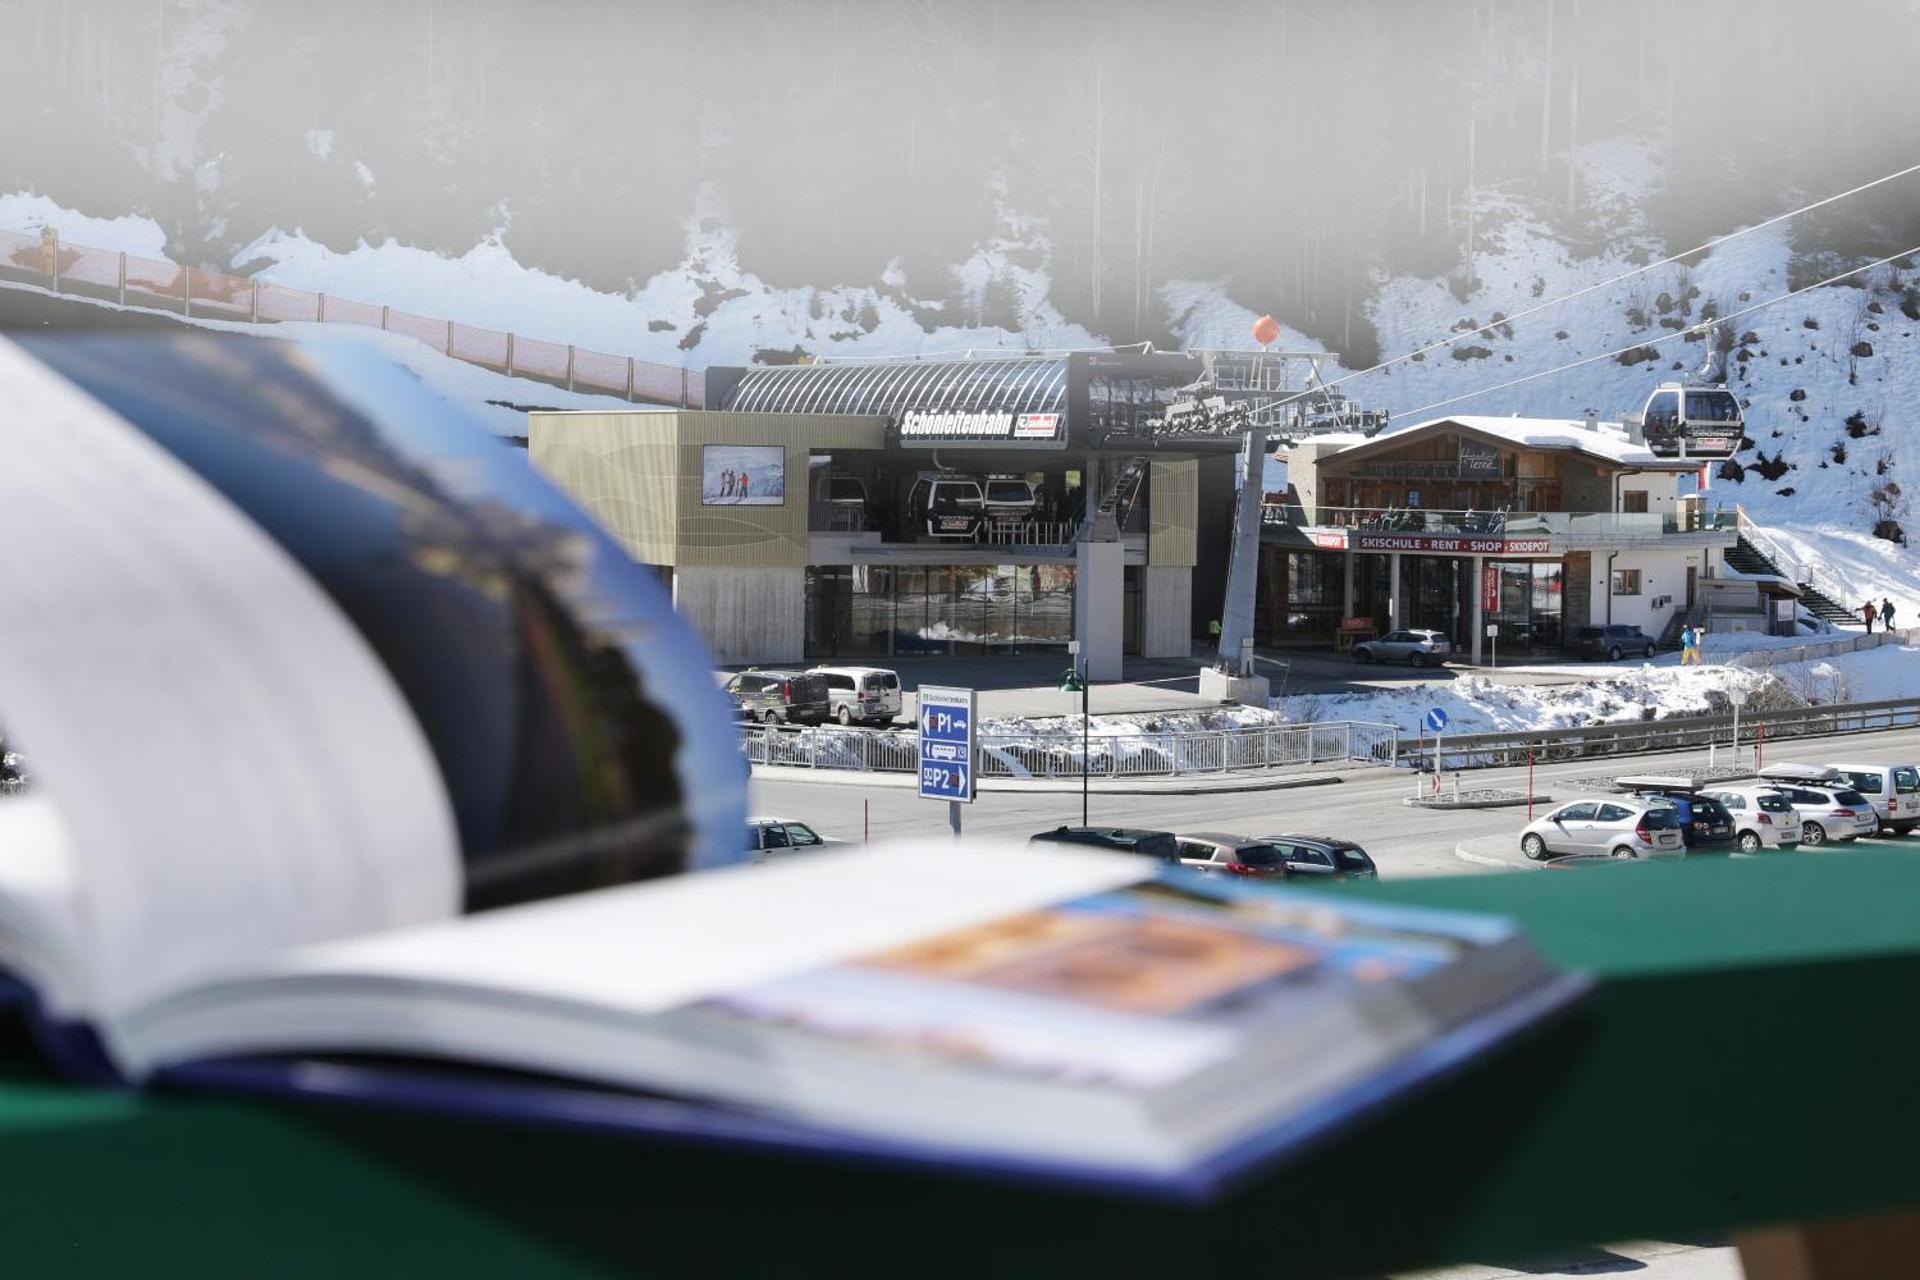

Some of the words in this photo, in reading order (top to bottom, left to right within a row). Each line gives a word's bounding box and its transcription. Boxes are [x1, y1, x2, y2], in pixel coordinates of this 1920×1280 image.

[901, 409, 1013, 435] Schönleitenbahn
[1361, 538, 1421, 549] SKISCHULE
[1431, 540, 1460, 550] RENT
[1470, 541, 1502, 552] SHOP
[1509, 542, 1549, 552] SKIDEPOT
[937, 712, 951, 733] P1
[933, 768, 950, 789] P2
